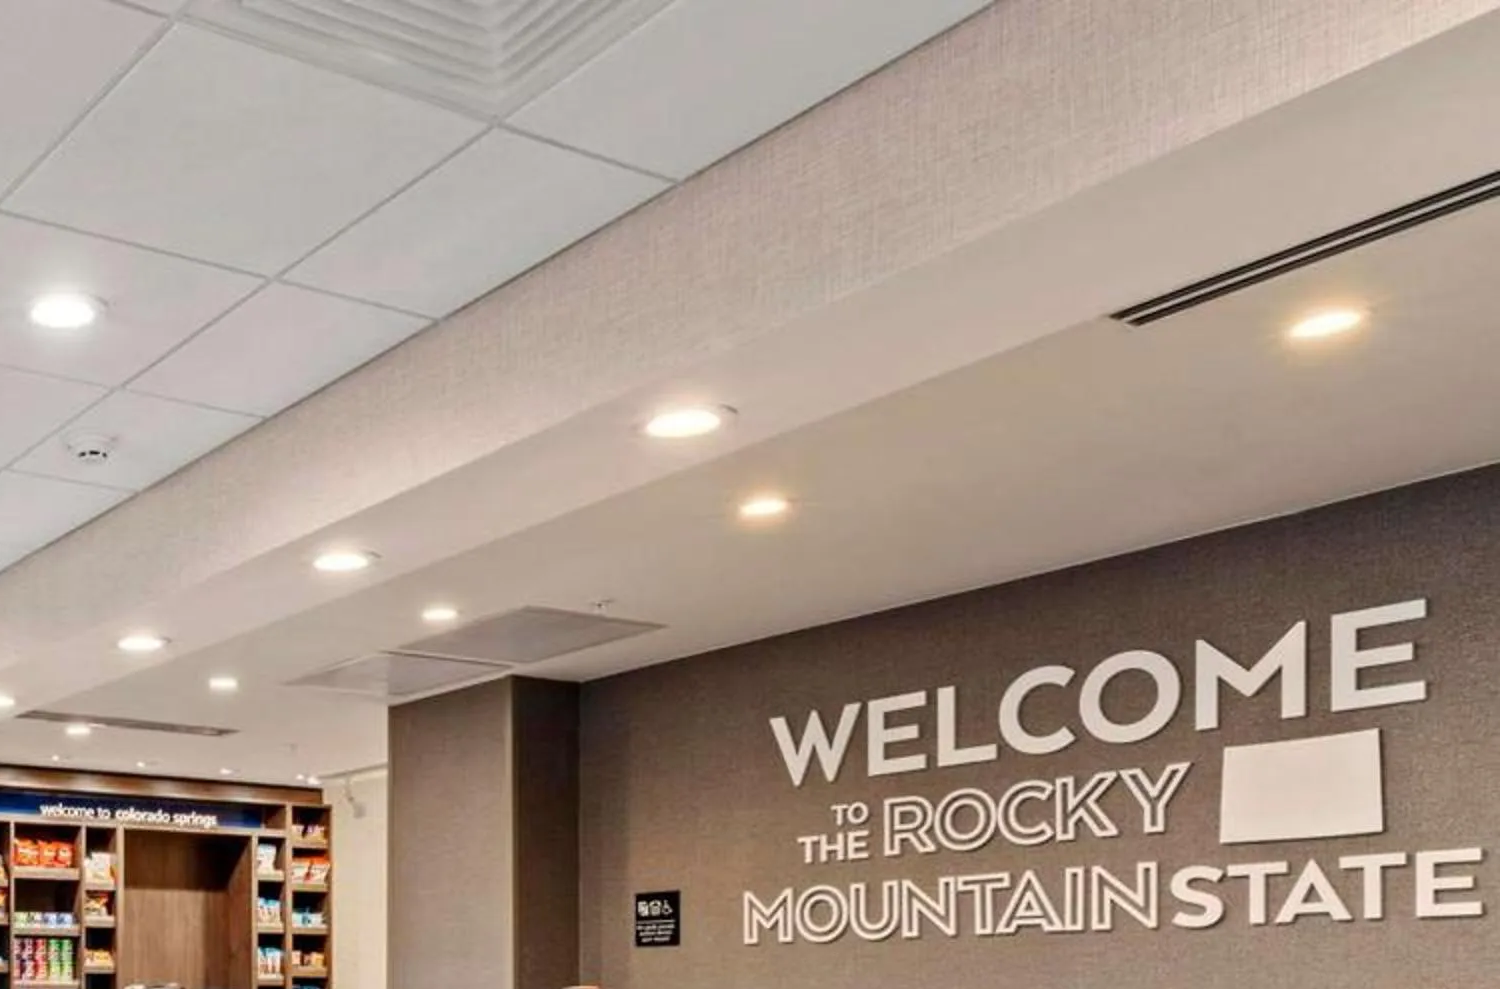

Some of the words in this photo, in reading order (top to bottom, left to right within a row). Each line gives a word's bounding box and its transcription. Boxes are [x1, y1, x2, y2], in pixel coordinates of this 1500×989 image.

[769, 598, 1427, 787] WELCOME
[39, 802, 95, 818] welcome
[97, 806, 111, 820] to
[114, 805, 170, 824] colorado
[172, 810, 218, 828] springs
[798, 829, 870, 864] THE
[882, 761, 1192, 858] ROCKY
[830, 801, 869, 827] TO
